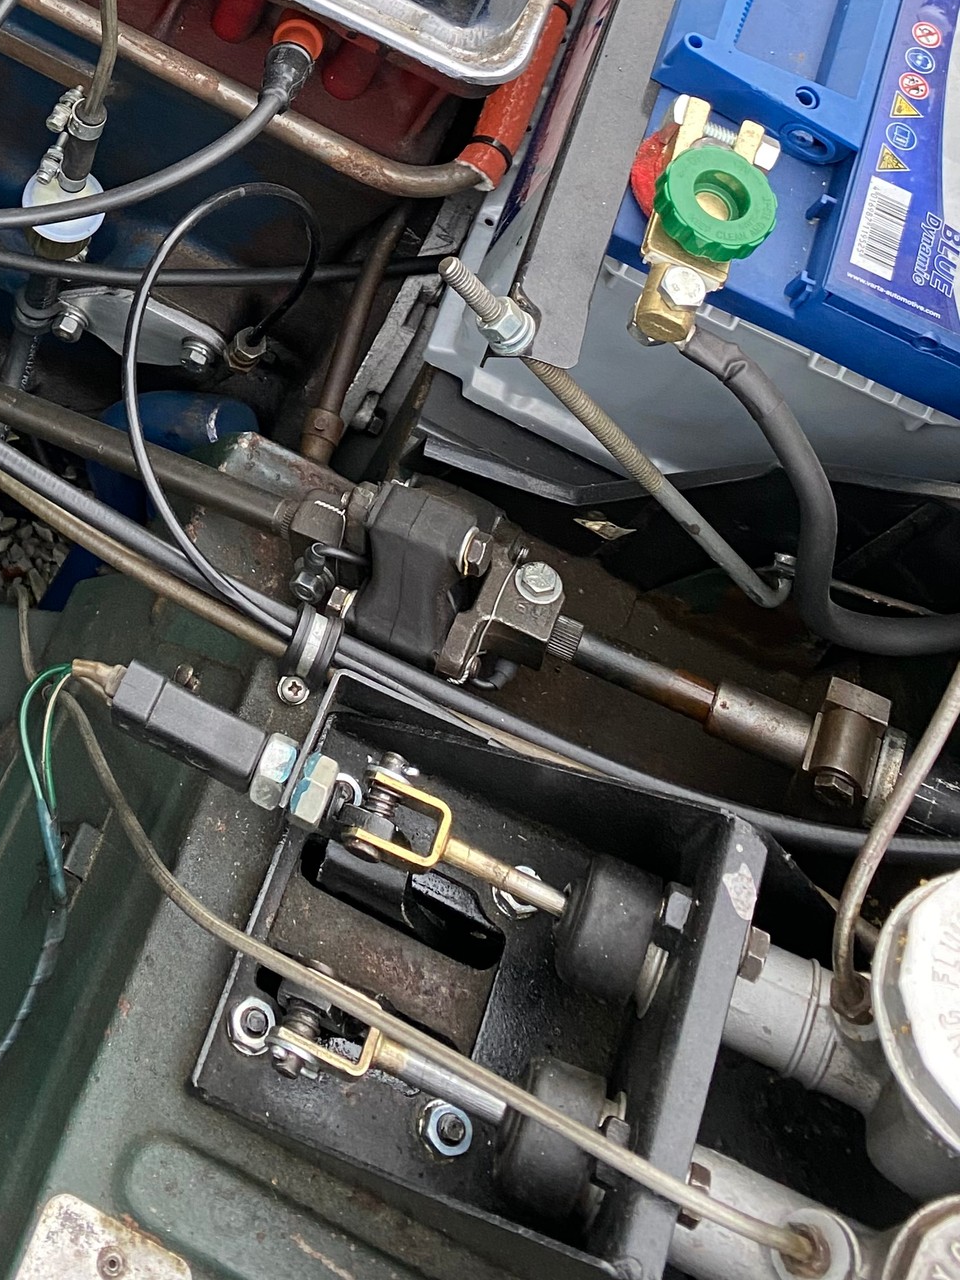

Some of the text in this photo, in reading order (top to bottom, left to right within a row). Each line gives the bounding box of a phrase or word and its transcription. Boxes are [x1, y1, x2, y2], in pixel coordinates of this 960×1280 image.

[912, 211, 943, 287] Dynamic
[929, 223, 960, 298] BLUE
[846, 271, 942, 320] www.varta-automotive.com
